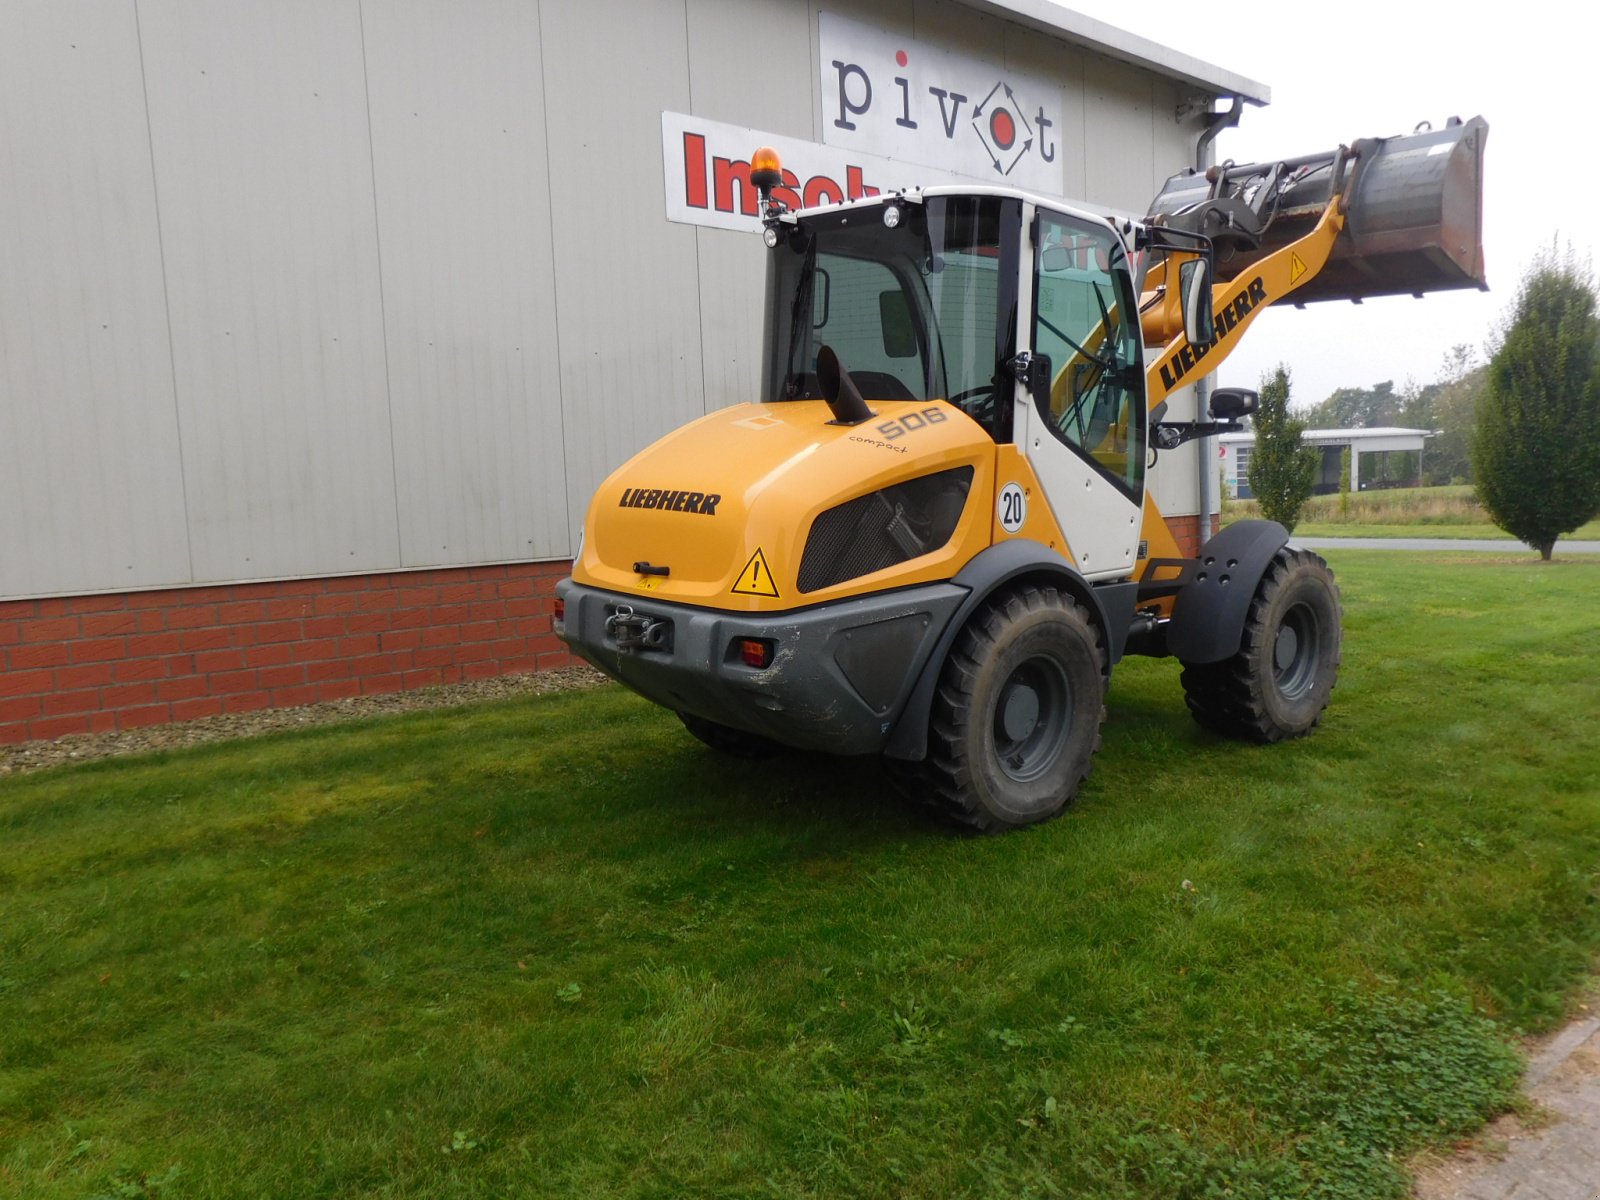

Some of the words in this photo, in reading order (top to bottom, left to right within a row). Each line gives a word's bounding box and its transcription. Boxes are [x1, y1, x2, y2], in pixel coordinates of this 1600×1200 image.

[831, 50, 1055, 163] pivot
[876, 407, 948, 440] 506
[848, 436, 908, 454] compact
[618, 488, 721, 516] LIEBHERR
[1003, 491, 1022, 524] 20
